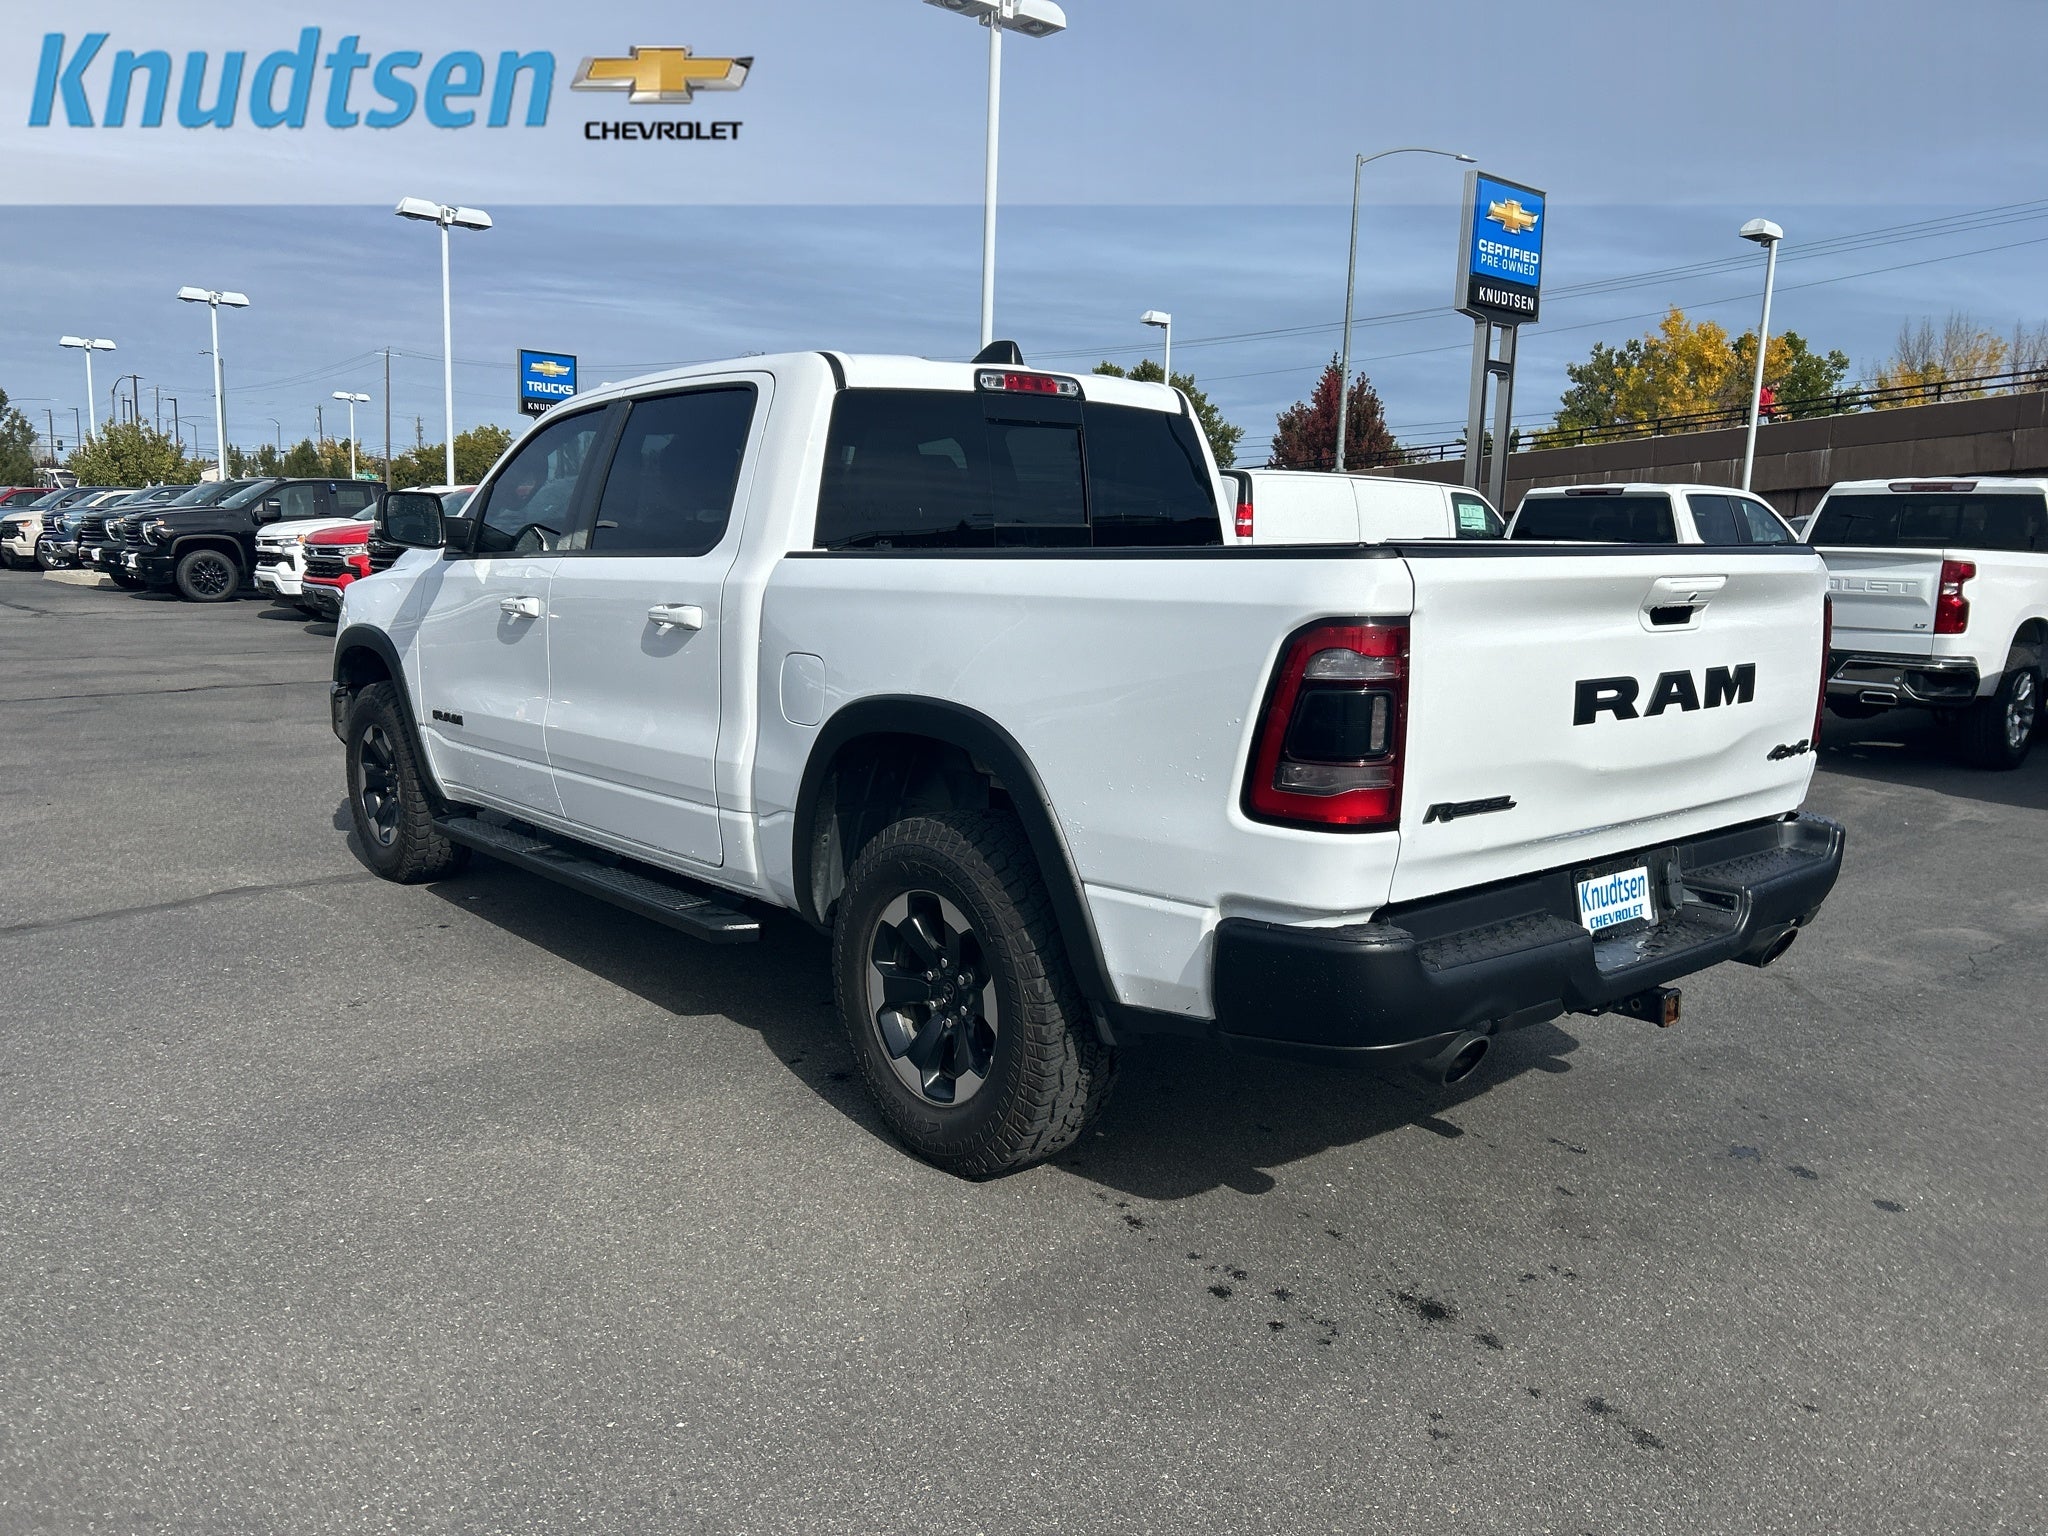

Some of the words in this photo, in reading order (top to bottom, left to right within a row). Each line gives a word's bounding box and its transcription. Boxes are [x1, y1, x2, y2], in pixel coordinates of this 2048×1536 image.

[1478, 238, 1539, 265] CERTIFIED
[1480, 255, 1535, 276] PRE-OWNED
[1479, 286, 1534, 311] KNUDTSEN
[526, 380, 574, 395] TRUCKS
[527, 402, 555, 411] KNUD
[1573, 662, 1756, 726] RAM
[1581, 874, 1646, 913] Knudtsen
[1589, 903, 1645, 929] CHEVROLET
